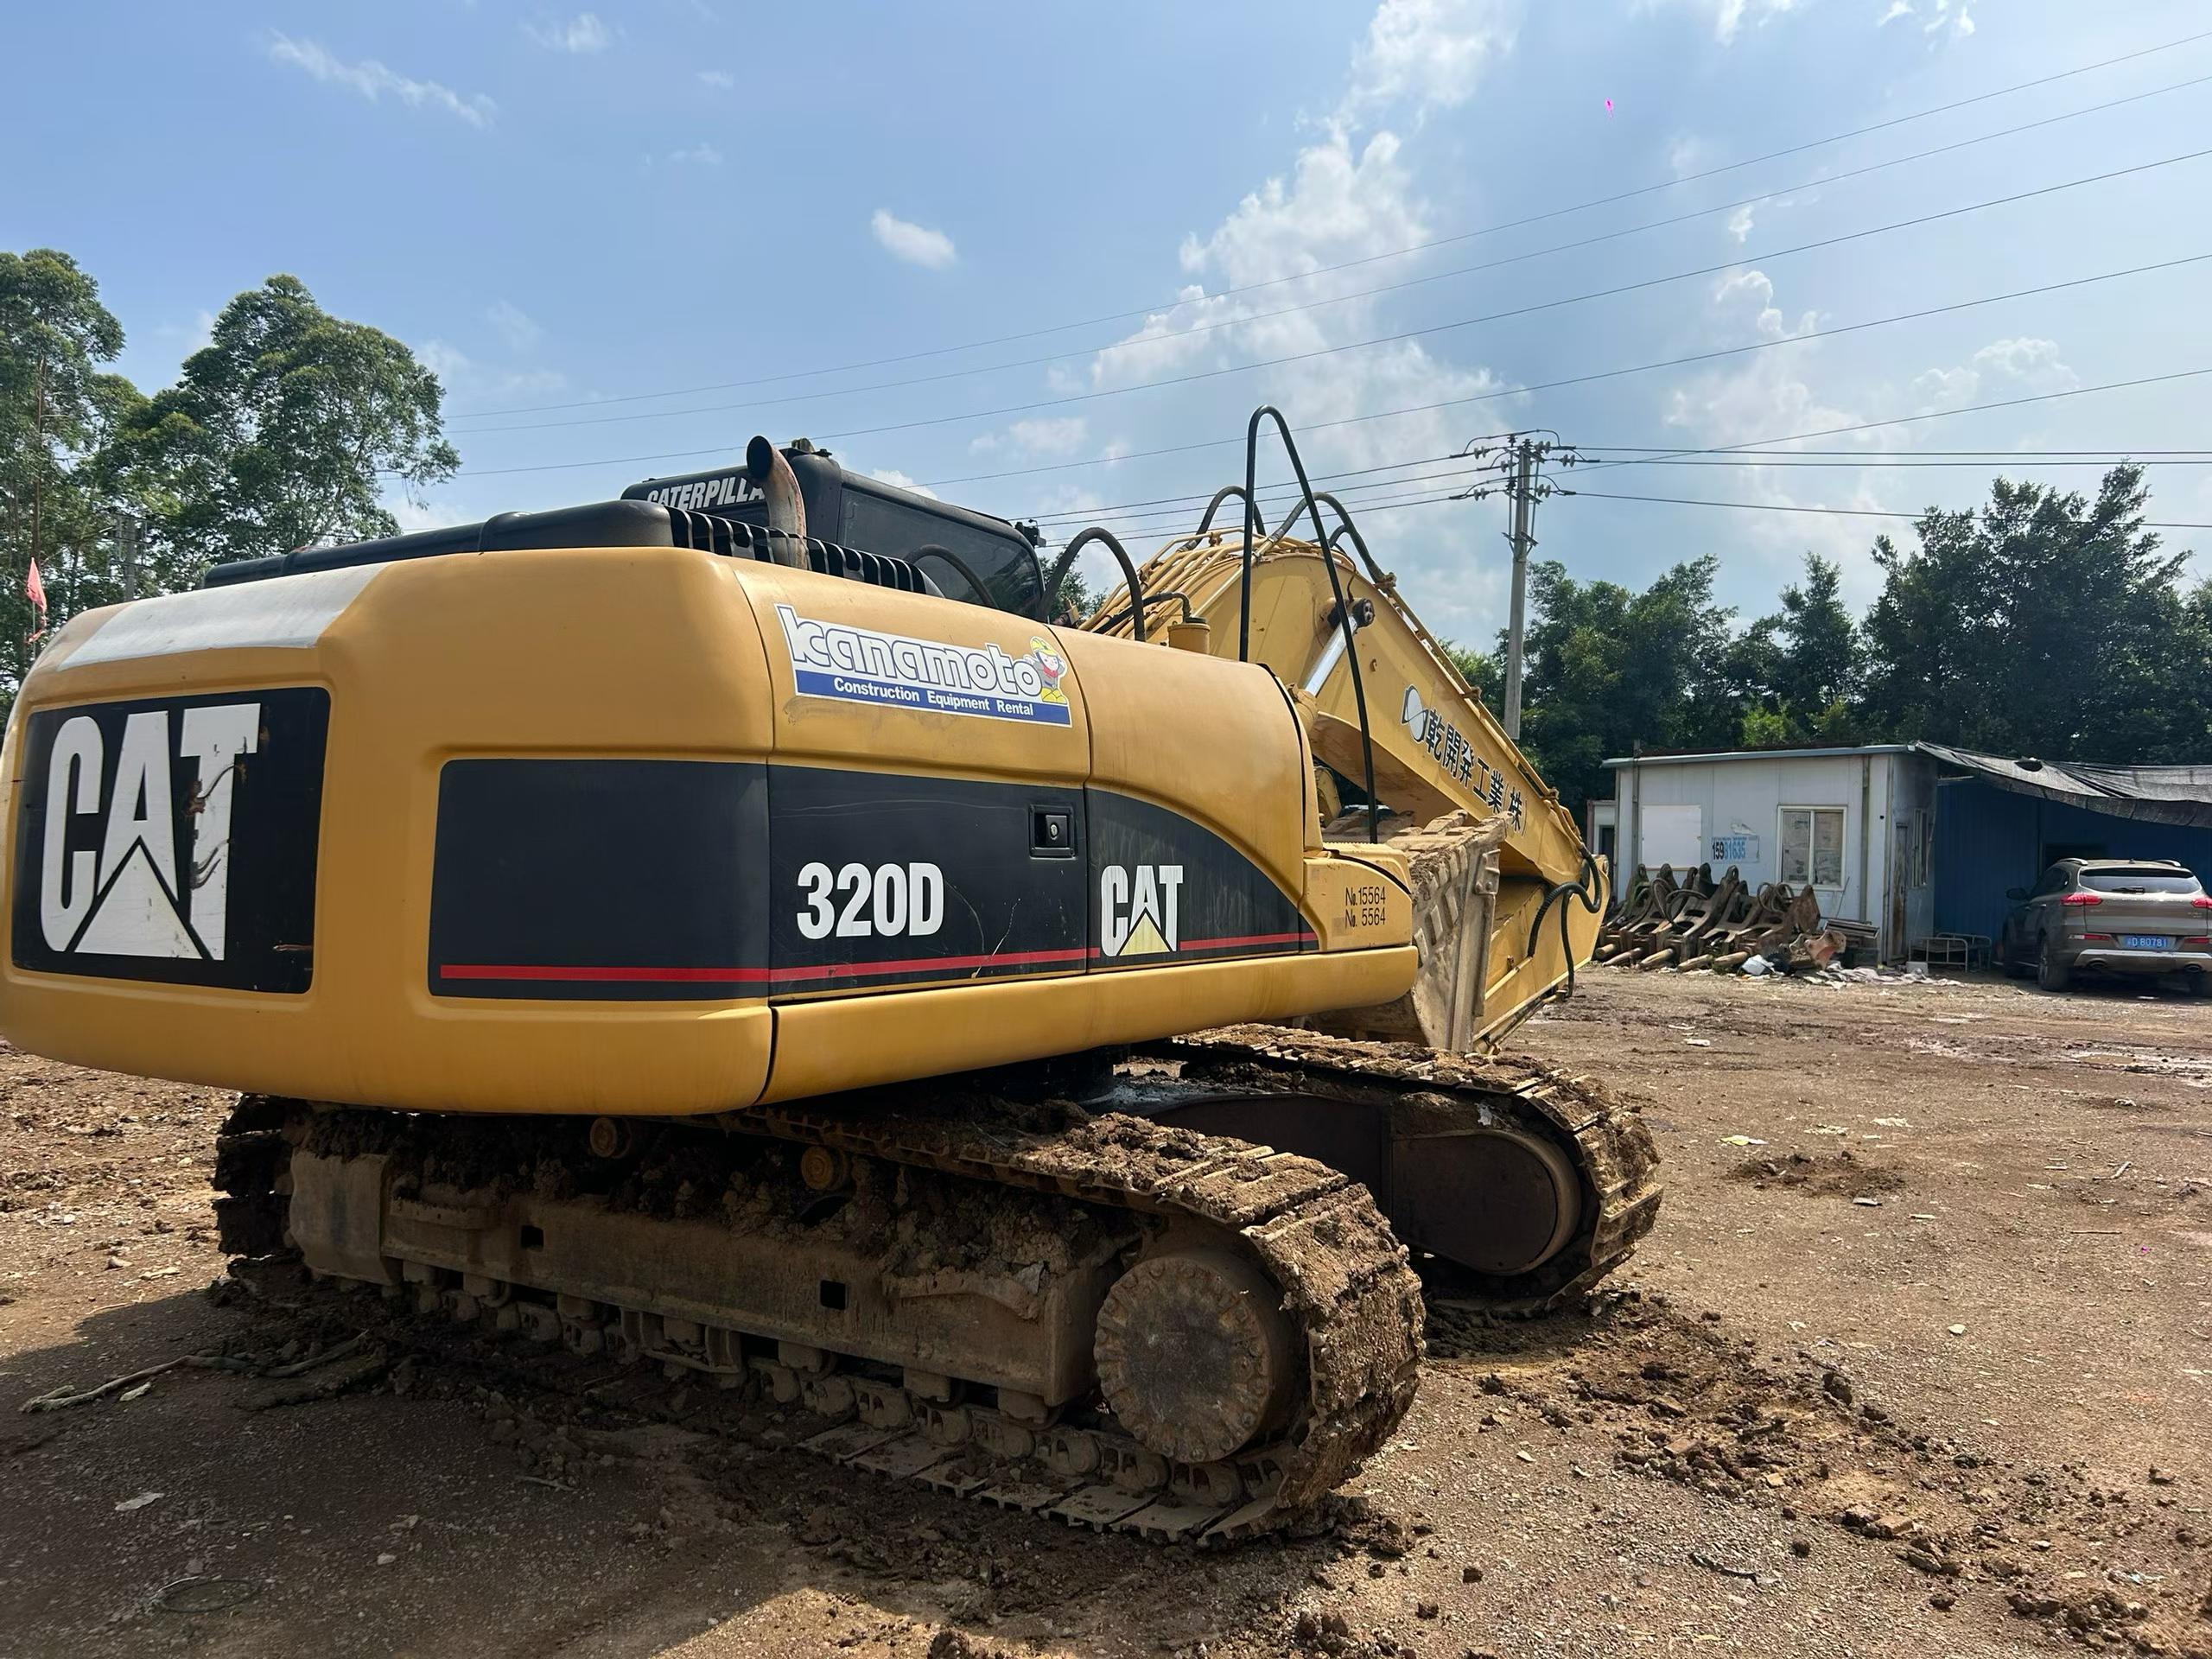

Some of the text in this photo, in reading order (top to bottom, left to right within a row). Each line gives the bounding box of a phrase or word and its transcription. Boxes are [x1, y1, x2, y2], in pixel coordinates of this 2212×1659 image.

[647, 476, 766, 512] CATERPILLA
[777, 605, 1043, 697] kanamoto
[834, 677, 1033, 716] Construction Equipment Rental
[41, 702, 261, 961] CAT
[797, 861, 944, 940] 320D
[1100, 864, 1184, 957] CAT
[1362, 907, 1386, 926] 5564
